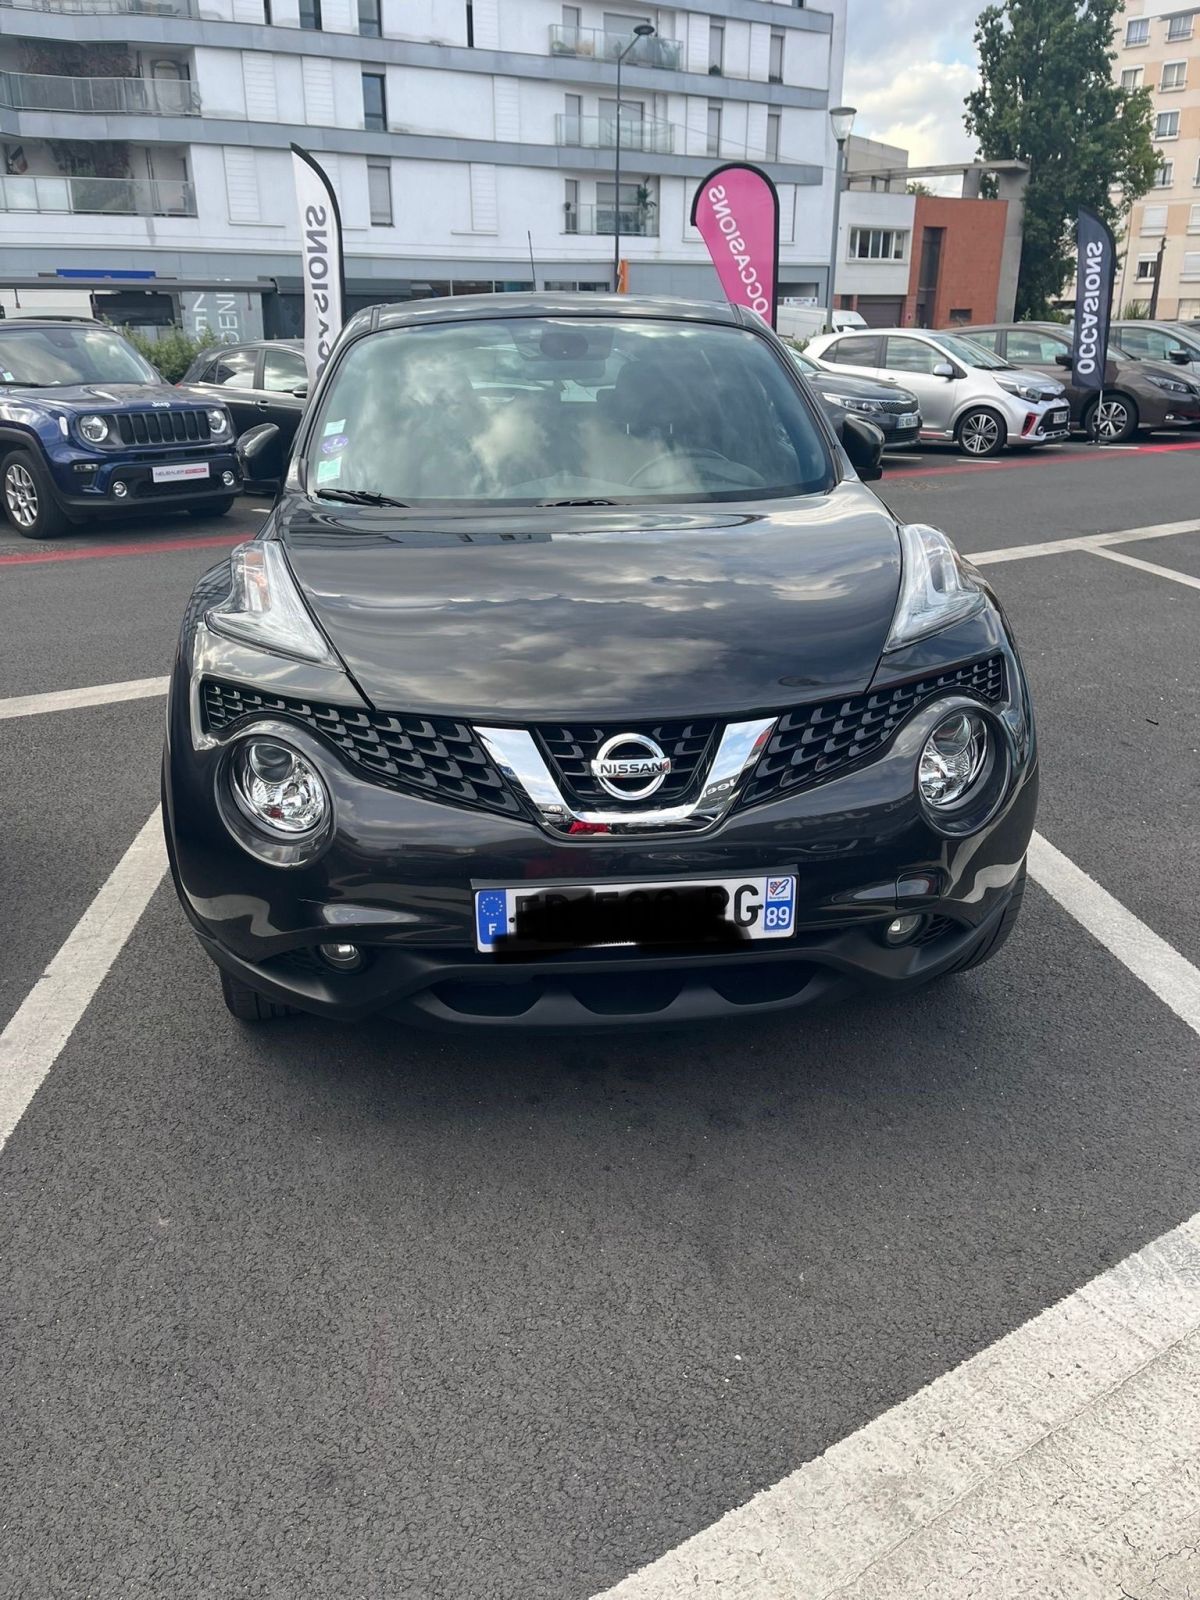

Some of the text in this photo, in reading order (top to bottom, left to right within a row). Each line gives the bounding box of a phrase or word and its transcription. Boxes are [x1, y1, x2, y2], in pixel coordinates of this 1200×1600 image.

[215, 278, 239, 345] DENI
[600, 762, 663, 774] NISSAN
[766, 906, 790, 927] 89
[488, 923, 497, 936] F
